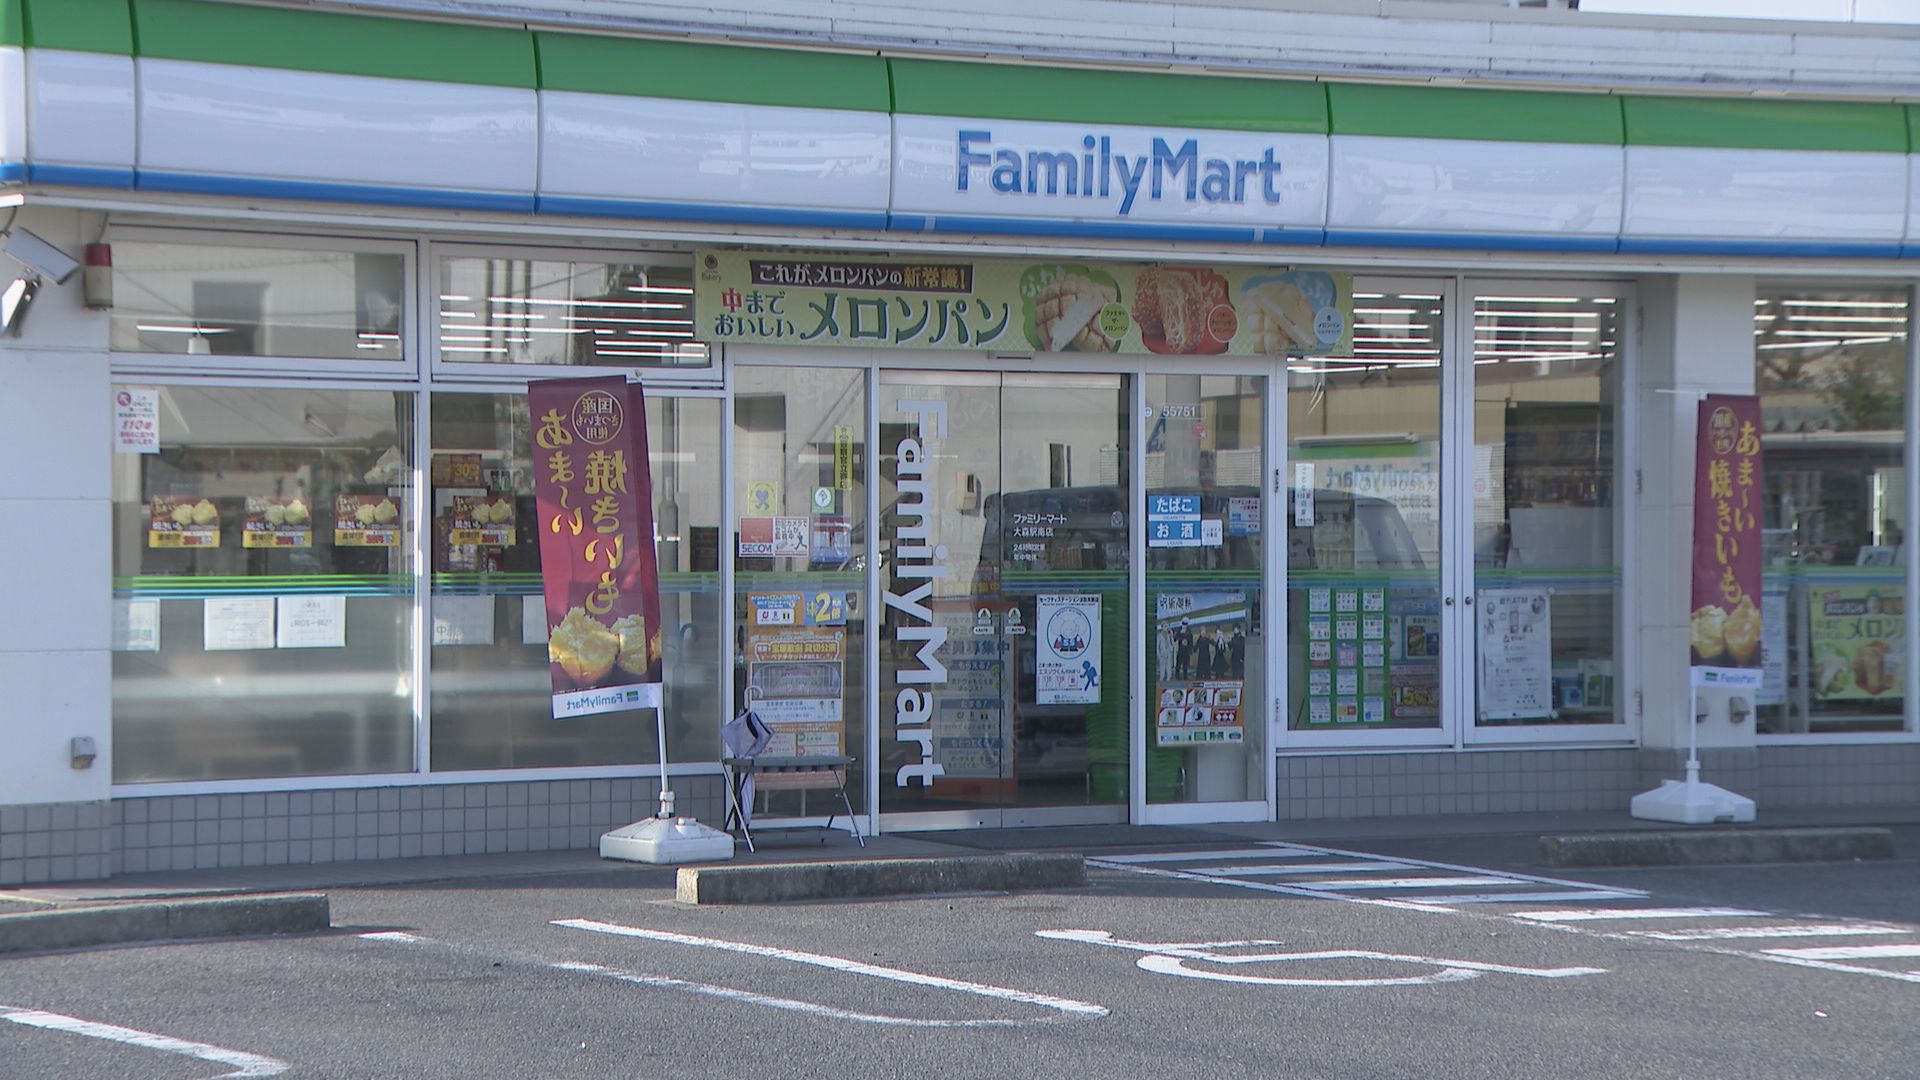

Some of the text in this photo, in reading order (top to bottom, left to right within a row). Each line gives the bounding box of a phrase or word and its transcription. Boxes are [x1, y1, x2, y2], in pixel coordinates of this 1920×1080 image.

[956, 129, 1281, 215] FamilyMart
[720, 288, 786, 315] 中まで
[714, 313, 796, 340] おいしい
[799, 292, 1012, 347] メロンパン
[1162, 406, 1196, 417] 55751
[1156, 497, 1193, 513] たばこ
[1013, 514, 1067, 524] ファミリーマート
[1013, 527, 1054, 537] 大森駅南店
[1709, 459, 1742, 604] 焼きいも
[741, 544, 772, 553] SECOM
[882, 400, 948, 788] FamilyMart
